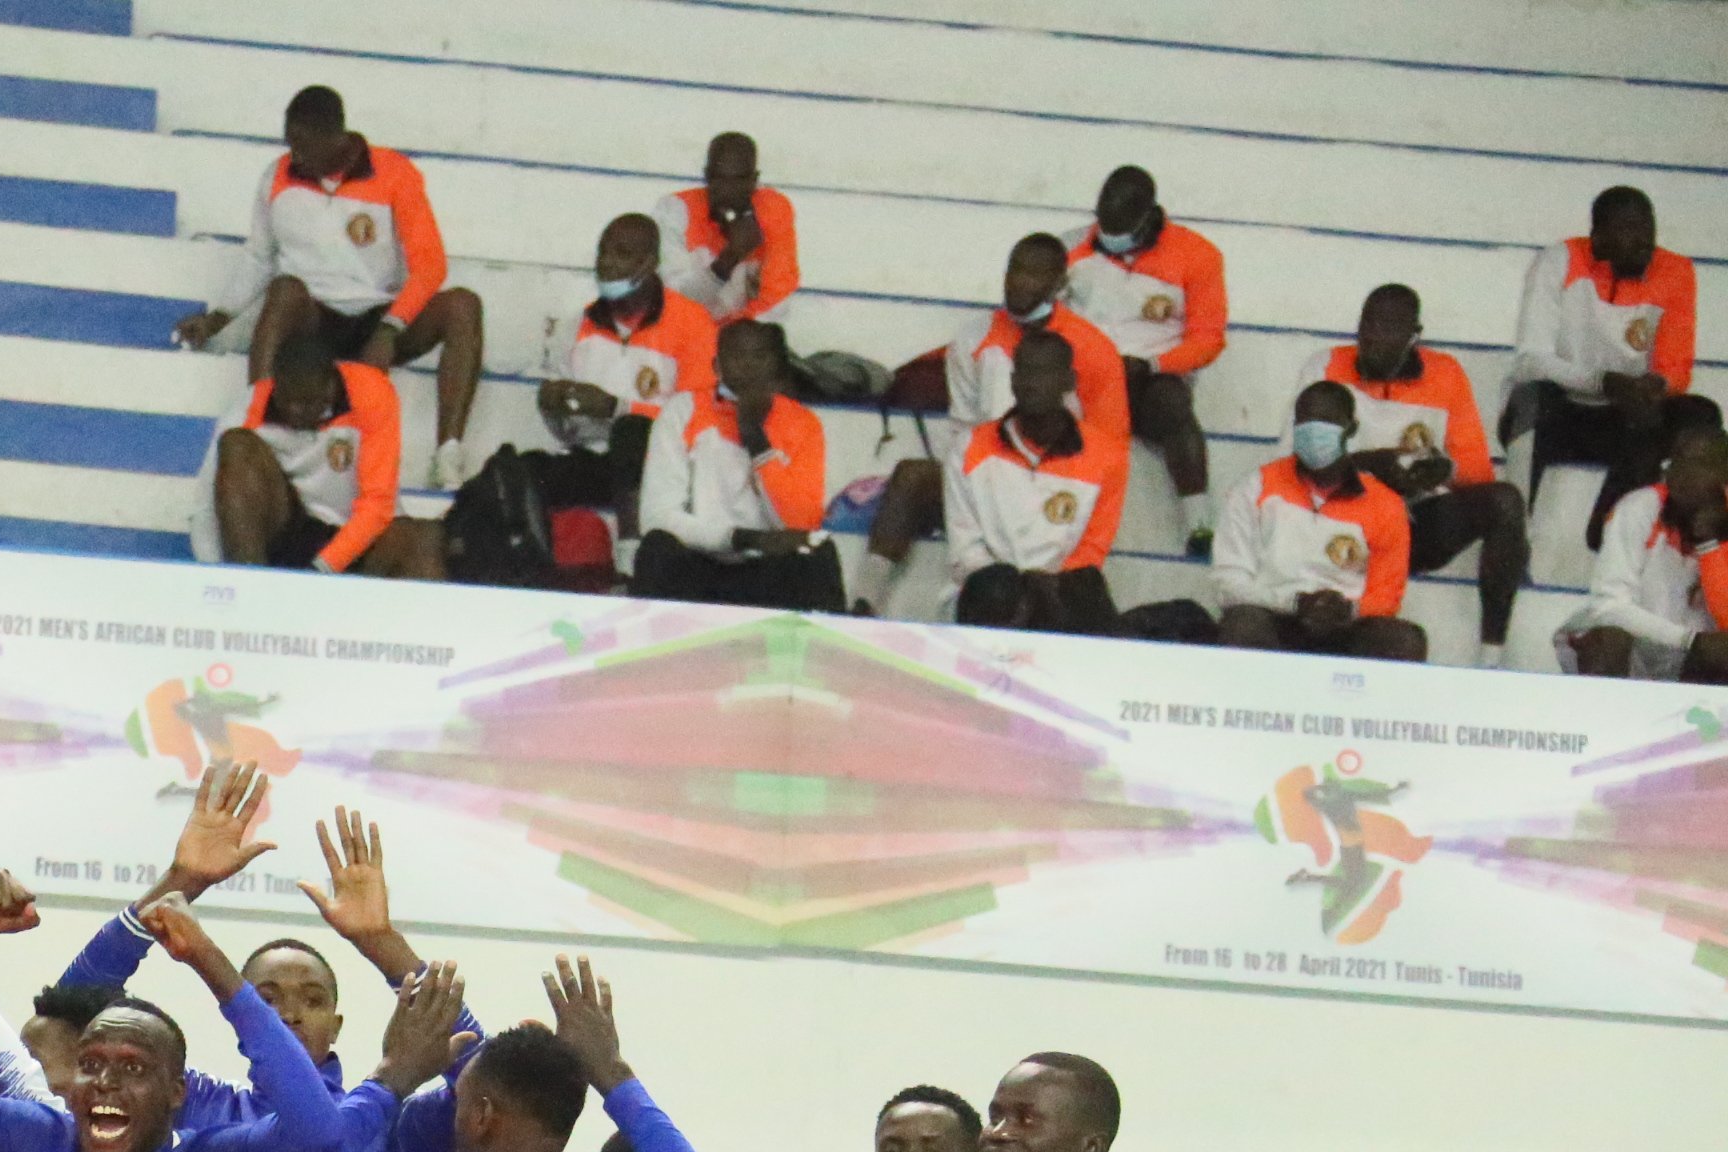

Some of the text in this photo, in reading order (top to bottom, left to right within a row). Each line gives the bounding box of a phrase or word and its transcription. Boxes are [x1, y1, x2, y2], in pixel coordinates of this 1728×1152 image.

[38, 617, 89, 642] MEN'S
[95, 621, 166, 646] AFRICAN
[173, 626, 216, 650] CLUB
[222, 630, 318, 658] VOLLEYBALL
[325, 637, 456, 668] CHAMPIONSHIP
[1119, 699, 1589, 754] 2021 MEN'S AFRICAN CLUB VOLLEYBALL CHAMPIONSHIP
[35, 857, 78, 880] From
[84, 860, 102, 882] 16
[114, 863, 131, 883] to
[1165, 944, 1208, 968] From
[1244, 949, 1260, 971] to
[1299, 953, 1340, 979] April
[1345, 956, 1387, 980] 2021
[1395, 960, 1442, 985] Tunis
[1458, 965, 1524, 991] Tunisia
